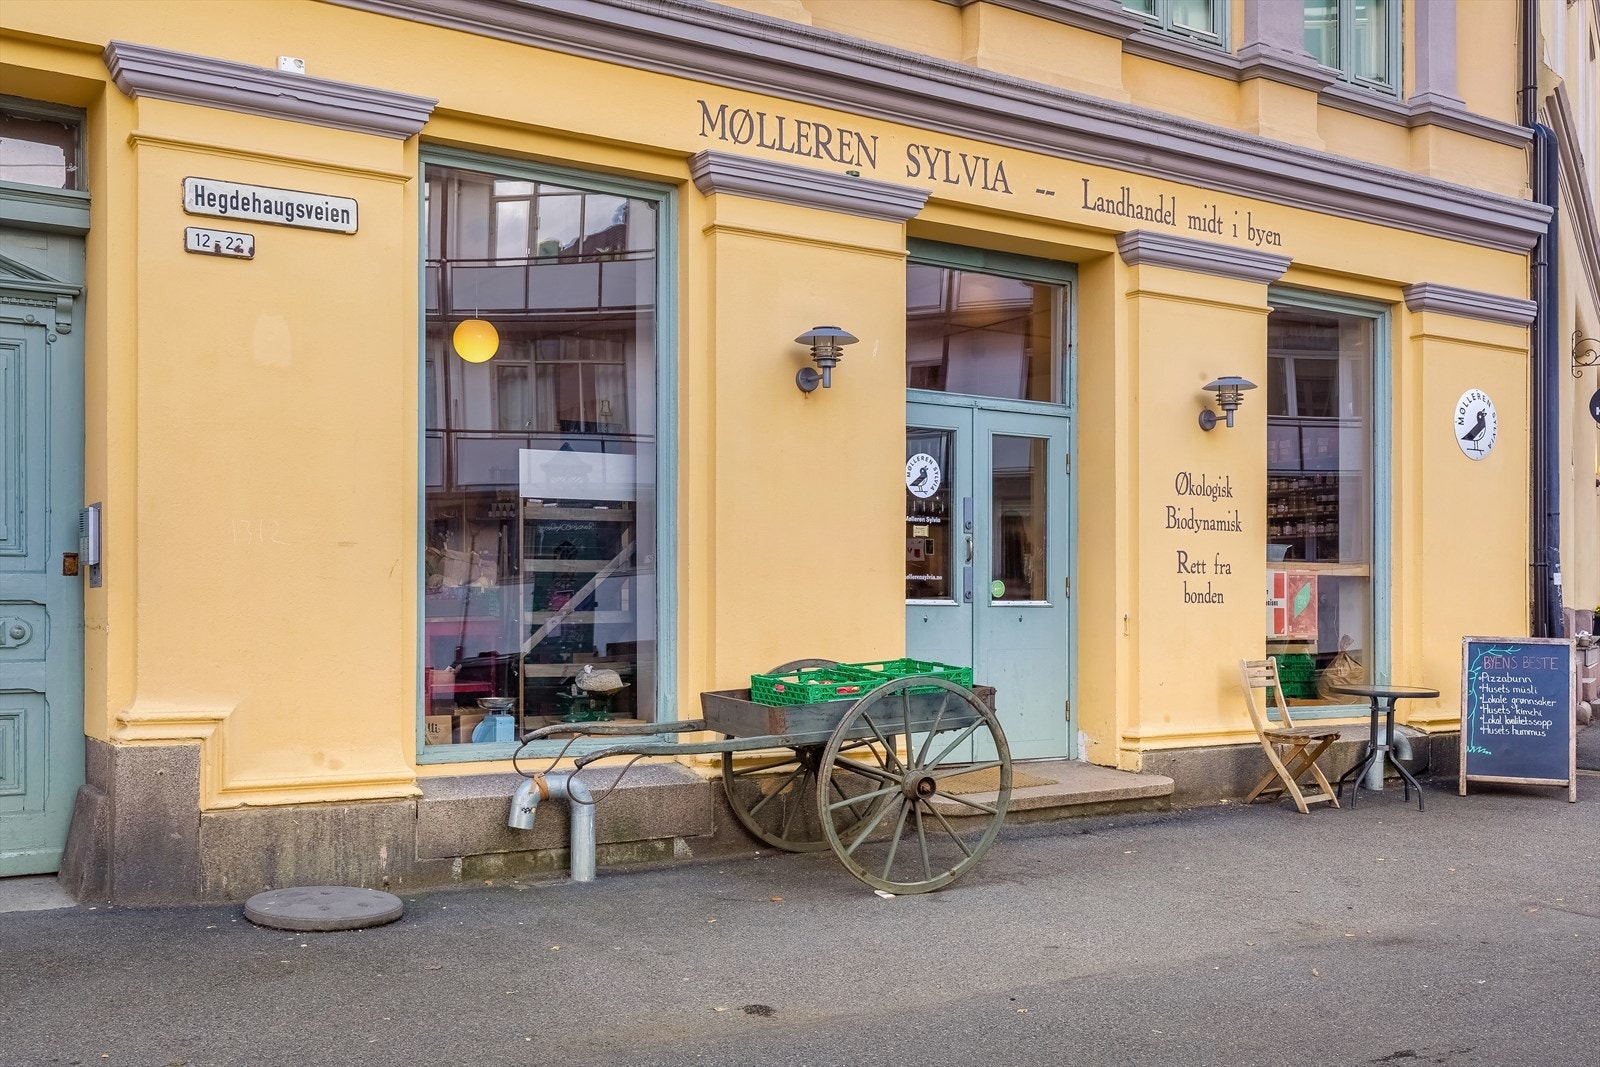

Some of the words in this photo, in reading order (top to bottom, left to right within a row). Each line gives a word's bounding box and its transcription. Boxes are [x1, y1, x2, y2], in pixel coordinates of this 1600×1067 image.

[696, 99, 879, 170] MØLLEREN
[906, 143, 1014, 195] SYLVIA
[1081, 178, 1177, 227] Landhandel
[1187, 204, 1224, 235] midt
[1232, 210, 1239, 238] i
[1247, 212, 1282, 247] byen
[194, 184, 350, 225] Hegdehaugsveien
[1175, 471, 1234, 502] Økologisk
[1165, 505, 1243, 534] Biodynamisk
[1176, 550, 1207, 575] Rett
[1213, 552, 1232, 575] fra
[1183, 580, 1225, 604] bonden
[1483, 655, 1518, 670] BYENS
[1522, 655, 1559, 670] BESTE
[1481, 671, 1533, 683] Pizzabunn
[1481, 683, 1510, 693] Husets
[1481, 693, 1508, 704] Lokale
[1511, 696, 1557, 709] grønnsaker
[1482, 703, 1511, 714] Husets
[1515, 704, 1543, 717] kimchi
[1482, 714, 1502, 725] Lokal
[1482, 725, 1511, 735] Husets
[1511, 725, 1547, 737] hummus
